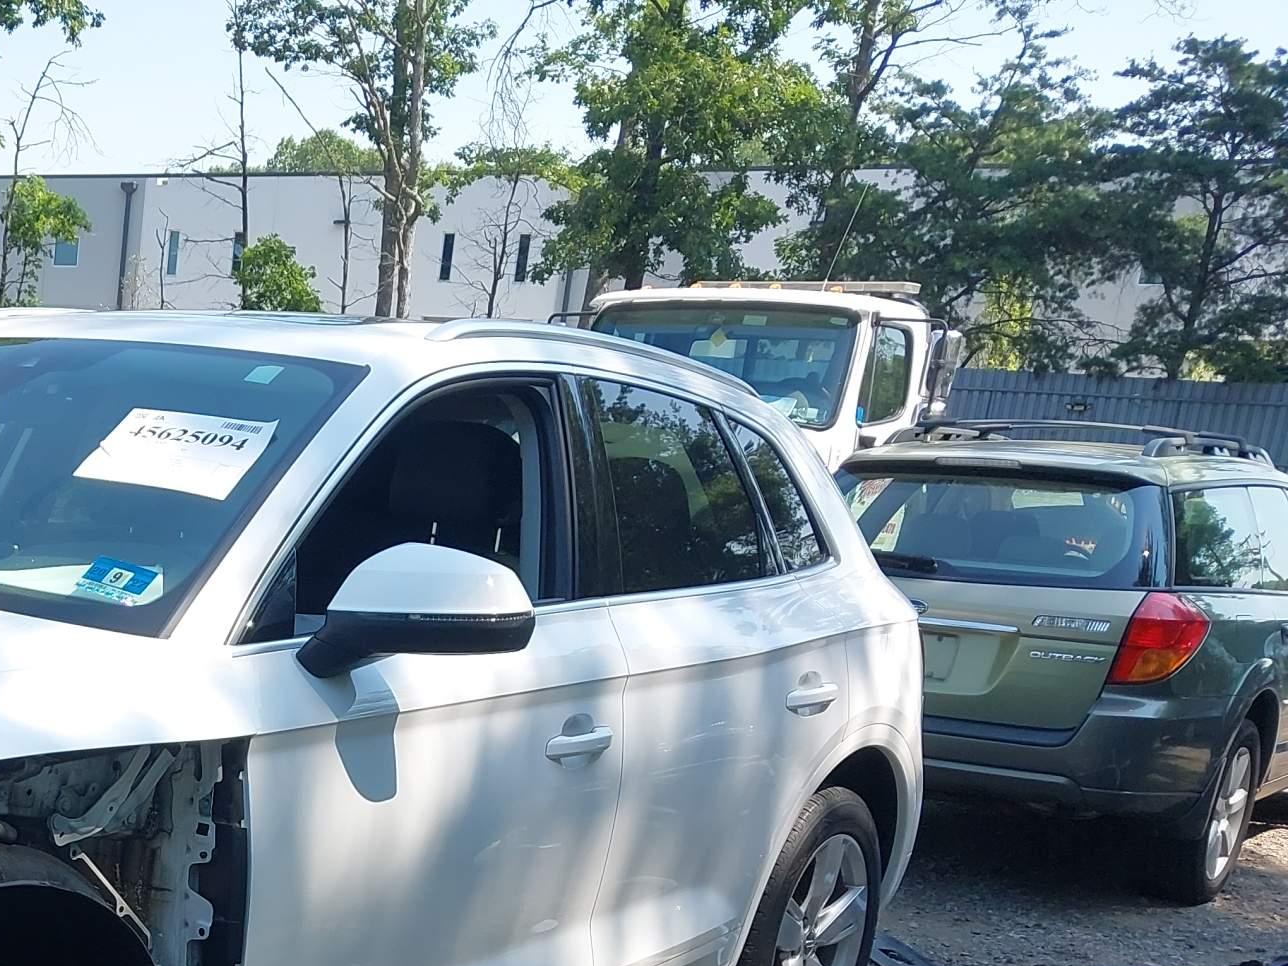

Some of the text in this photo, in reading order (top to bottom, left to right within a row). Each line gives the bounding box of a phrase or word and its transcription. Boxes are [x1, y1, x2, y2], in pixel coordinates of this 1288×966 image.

[129, 425, 250, 451] 45625094
[109, 571, 123, 584] 9
[1029, 651, 1106, 663] OUTBACK
